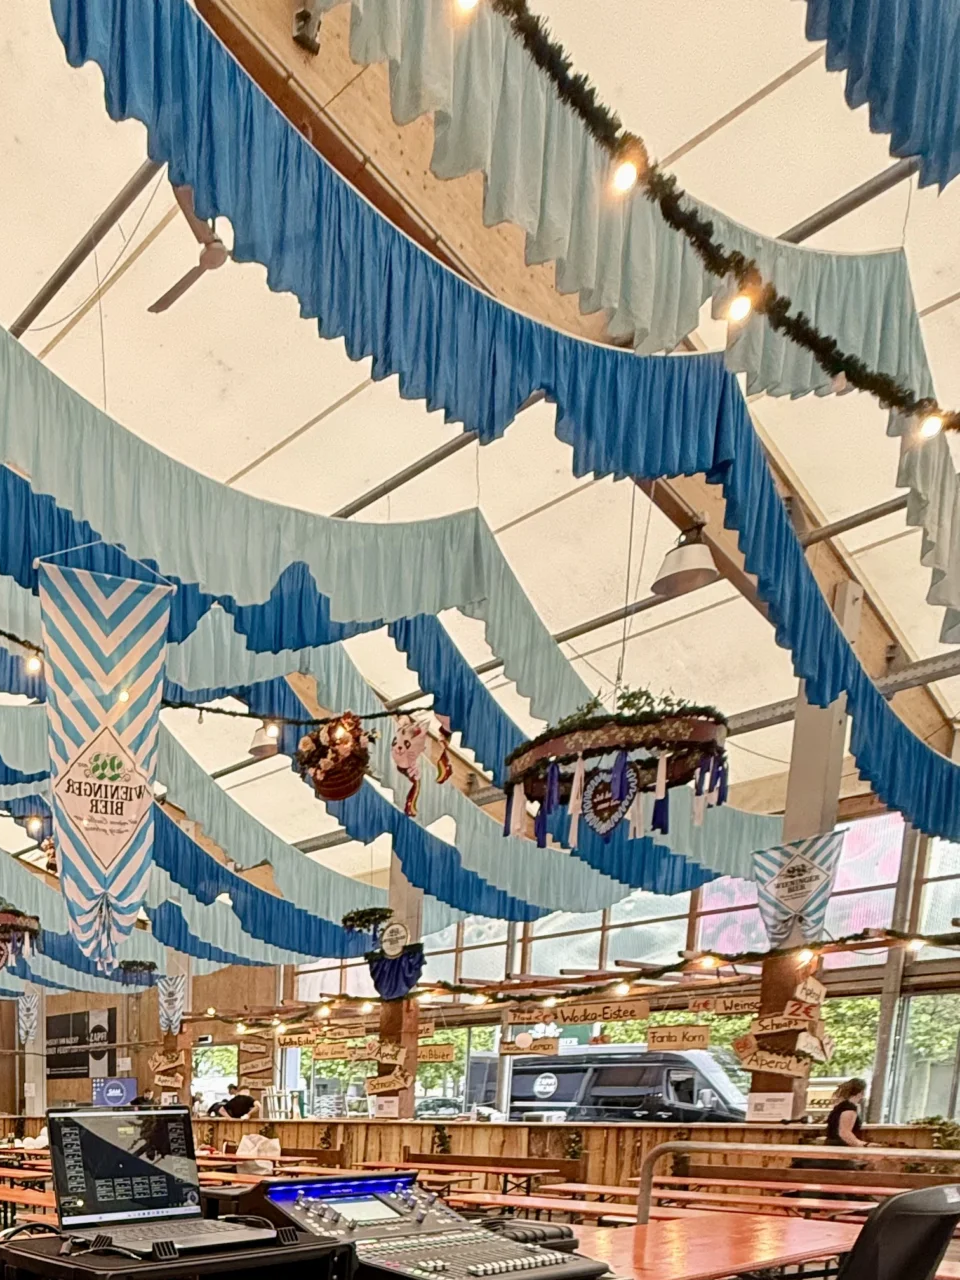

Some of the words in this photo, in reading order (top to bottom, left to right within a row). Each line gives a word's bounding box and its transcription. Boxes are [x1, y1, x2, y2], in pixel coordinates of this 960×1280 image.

[560, 1005, 637, 1022] Wodka-Eistee
[789, 1003, 818, 1018] 2€
[649, 1031, 678, 1043] Fanta
[682, 1029, 705, 1043] Korn
[747, 1053, 793, 1071] Aperol
